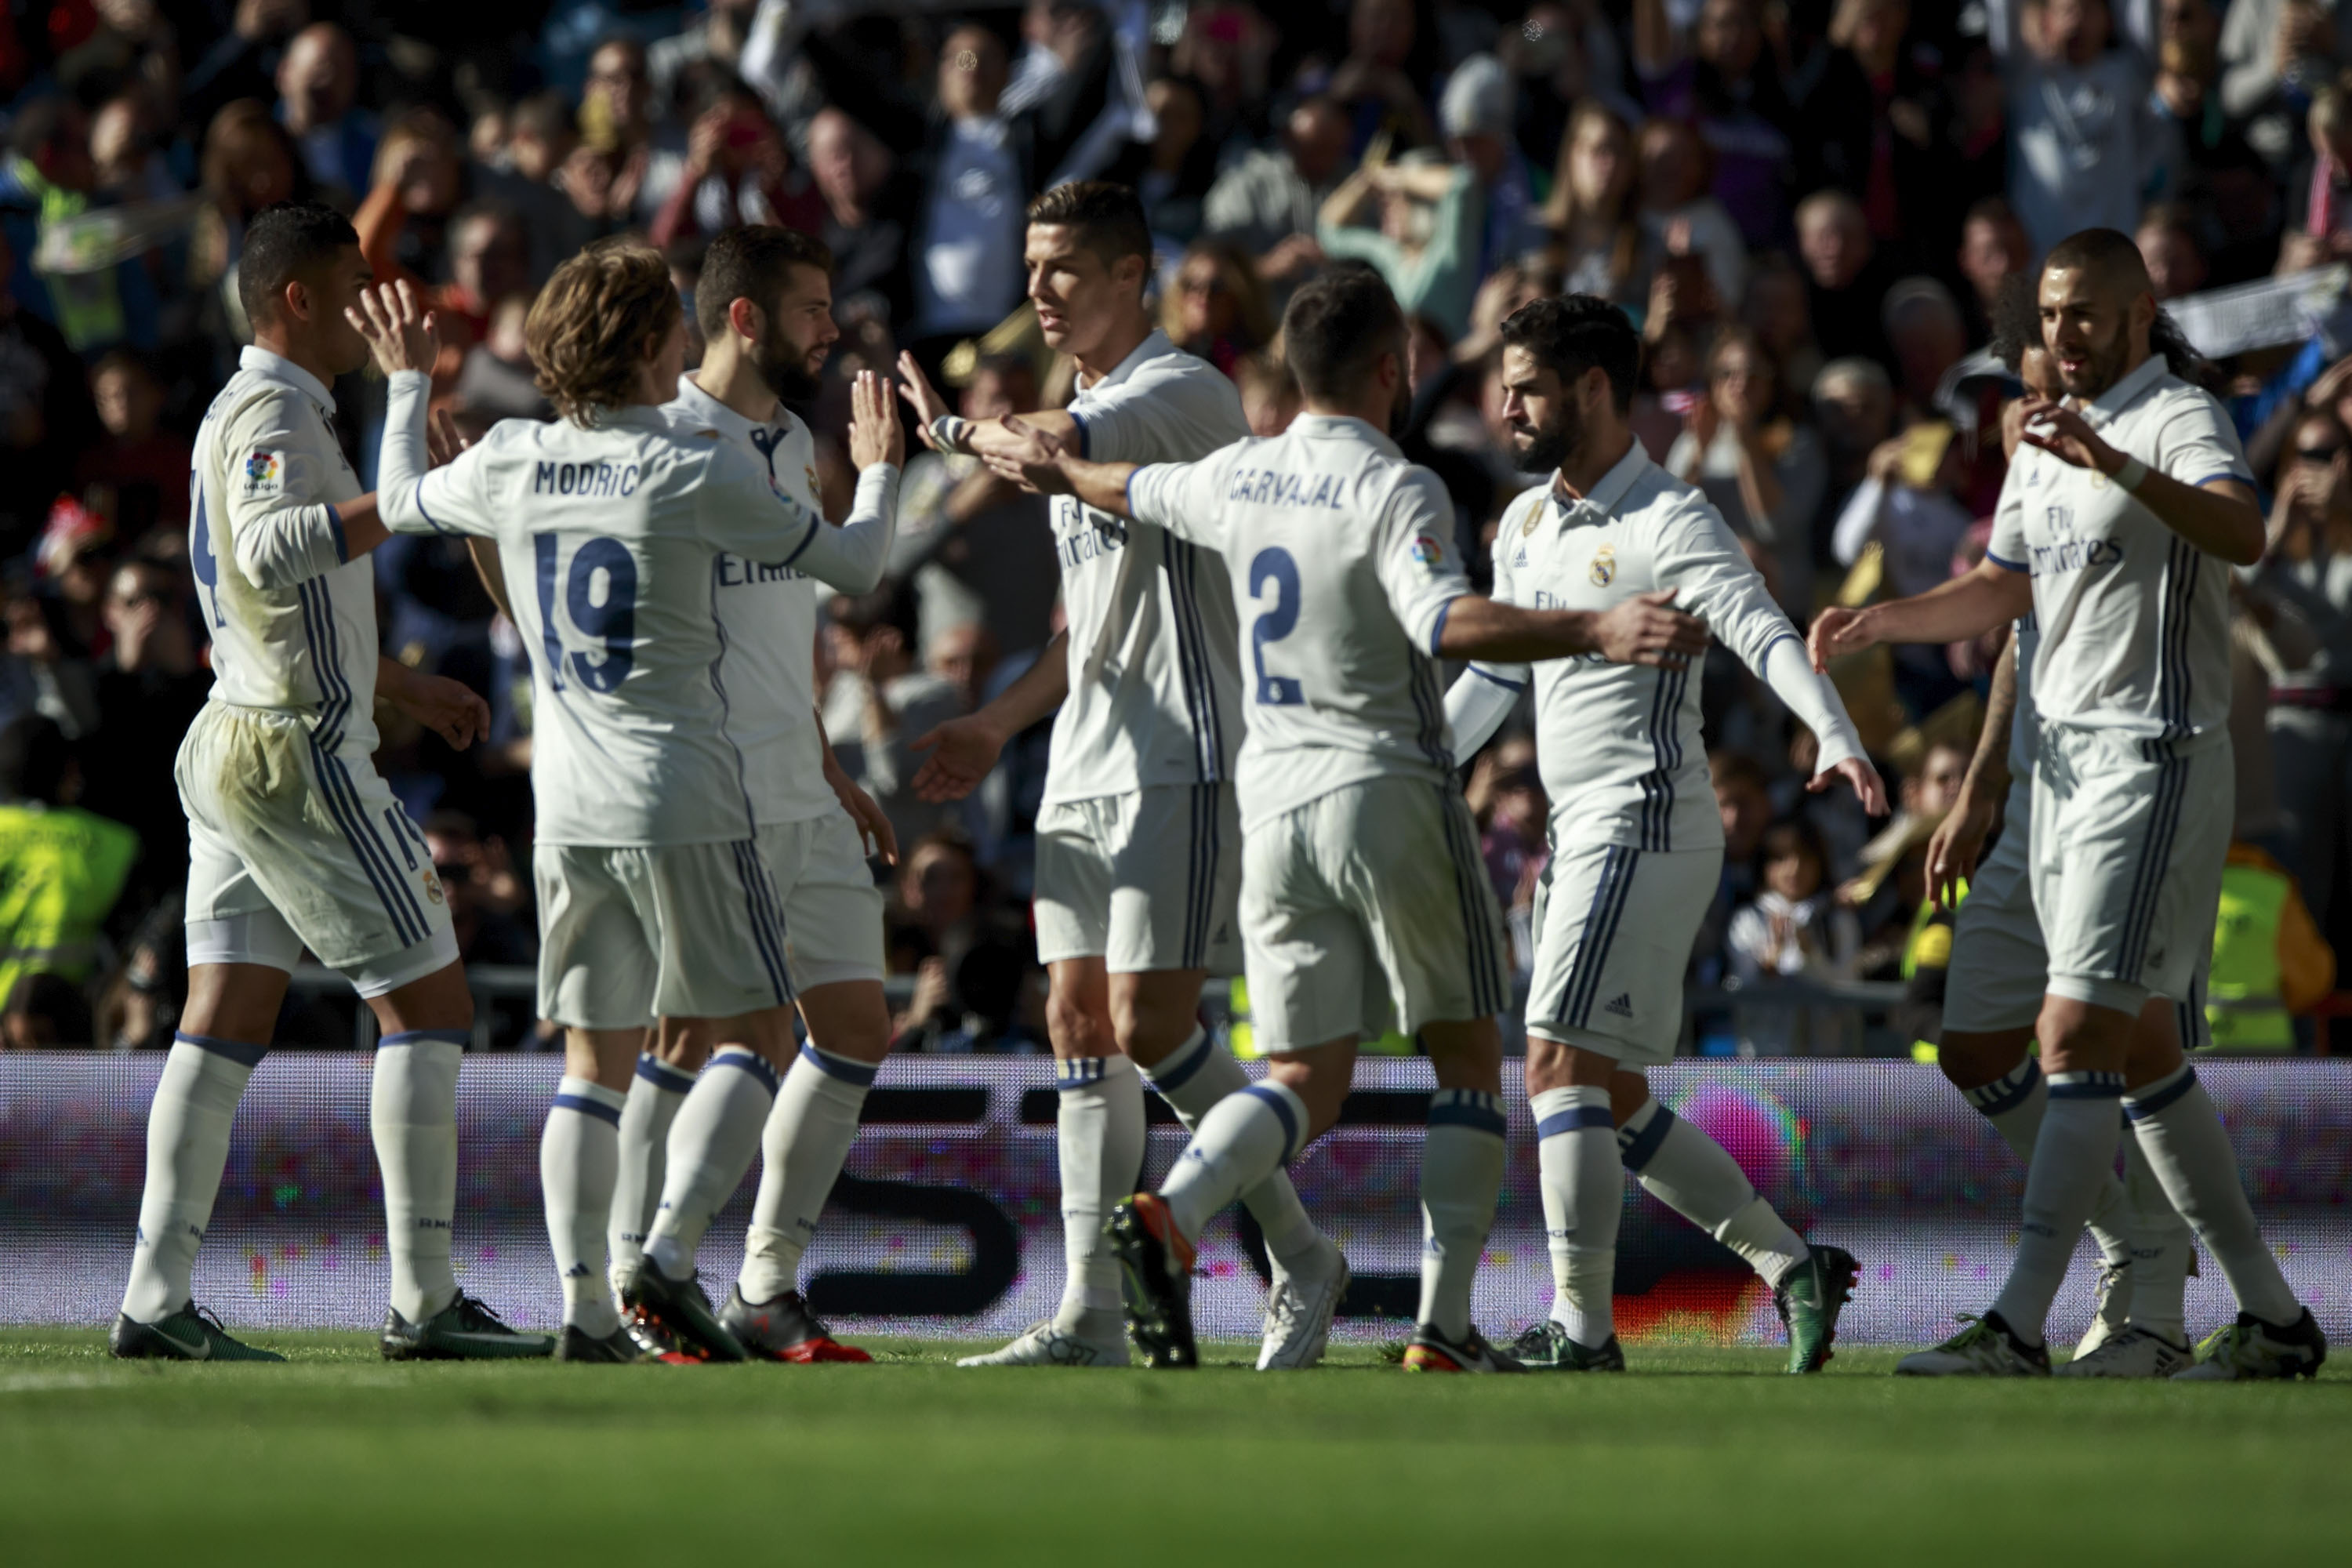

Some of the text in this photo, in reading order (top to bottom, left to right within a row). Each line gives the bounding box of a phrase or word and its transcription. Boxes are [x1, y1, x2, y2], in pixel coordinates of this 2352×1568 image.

[1230, 469, 1346, 510] CARVAJAL
[533, 532, 638, 694] 19
[1250, 546, 1305, 706] 2
